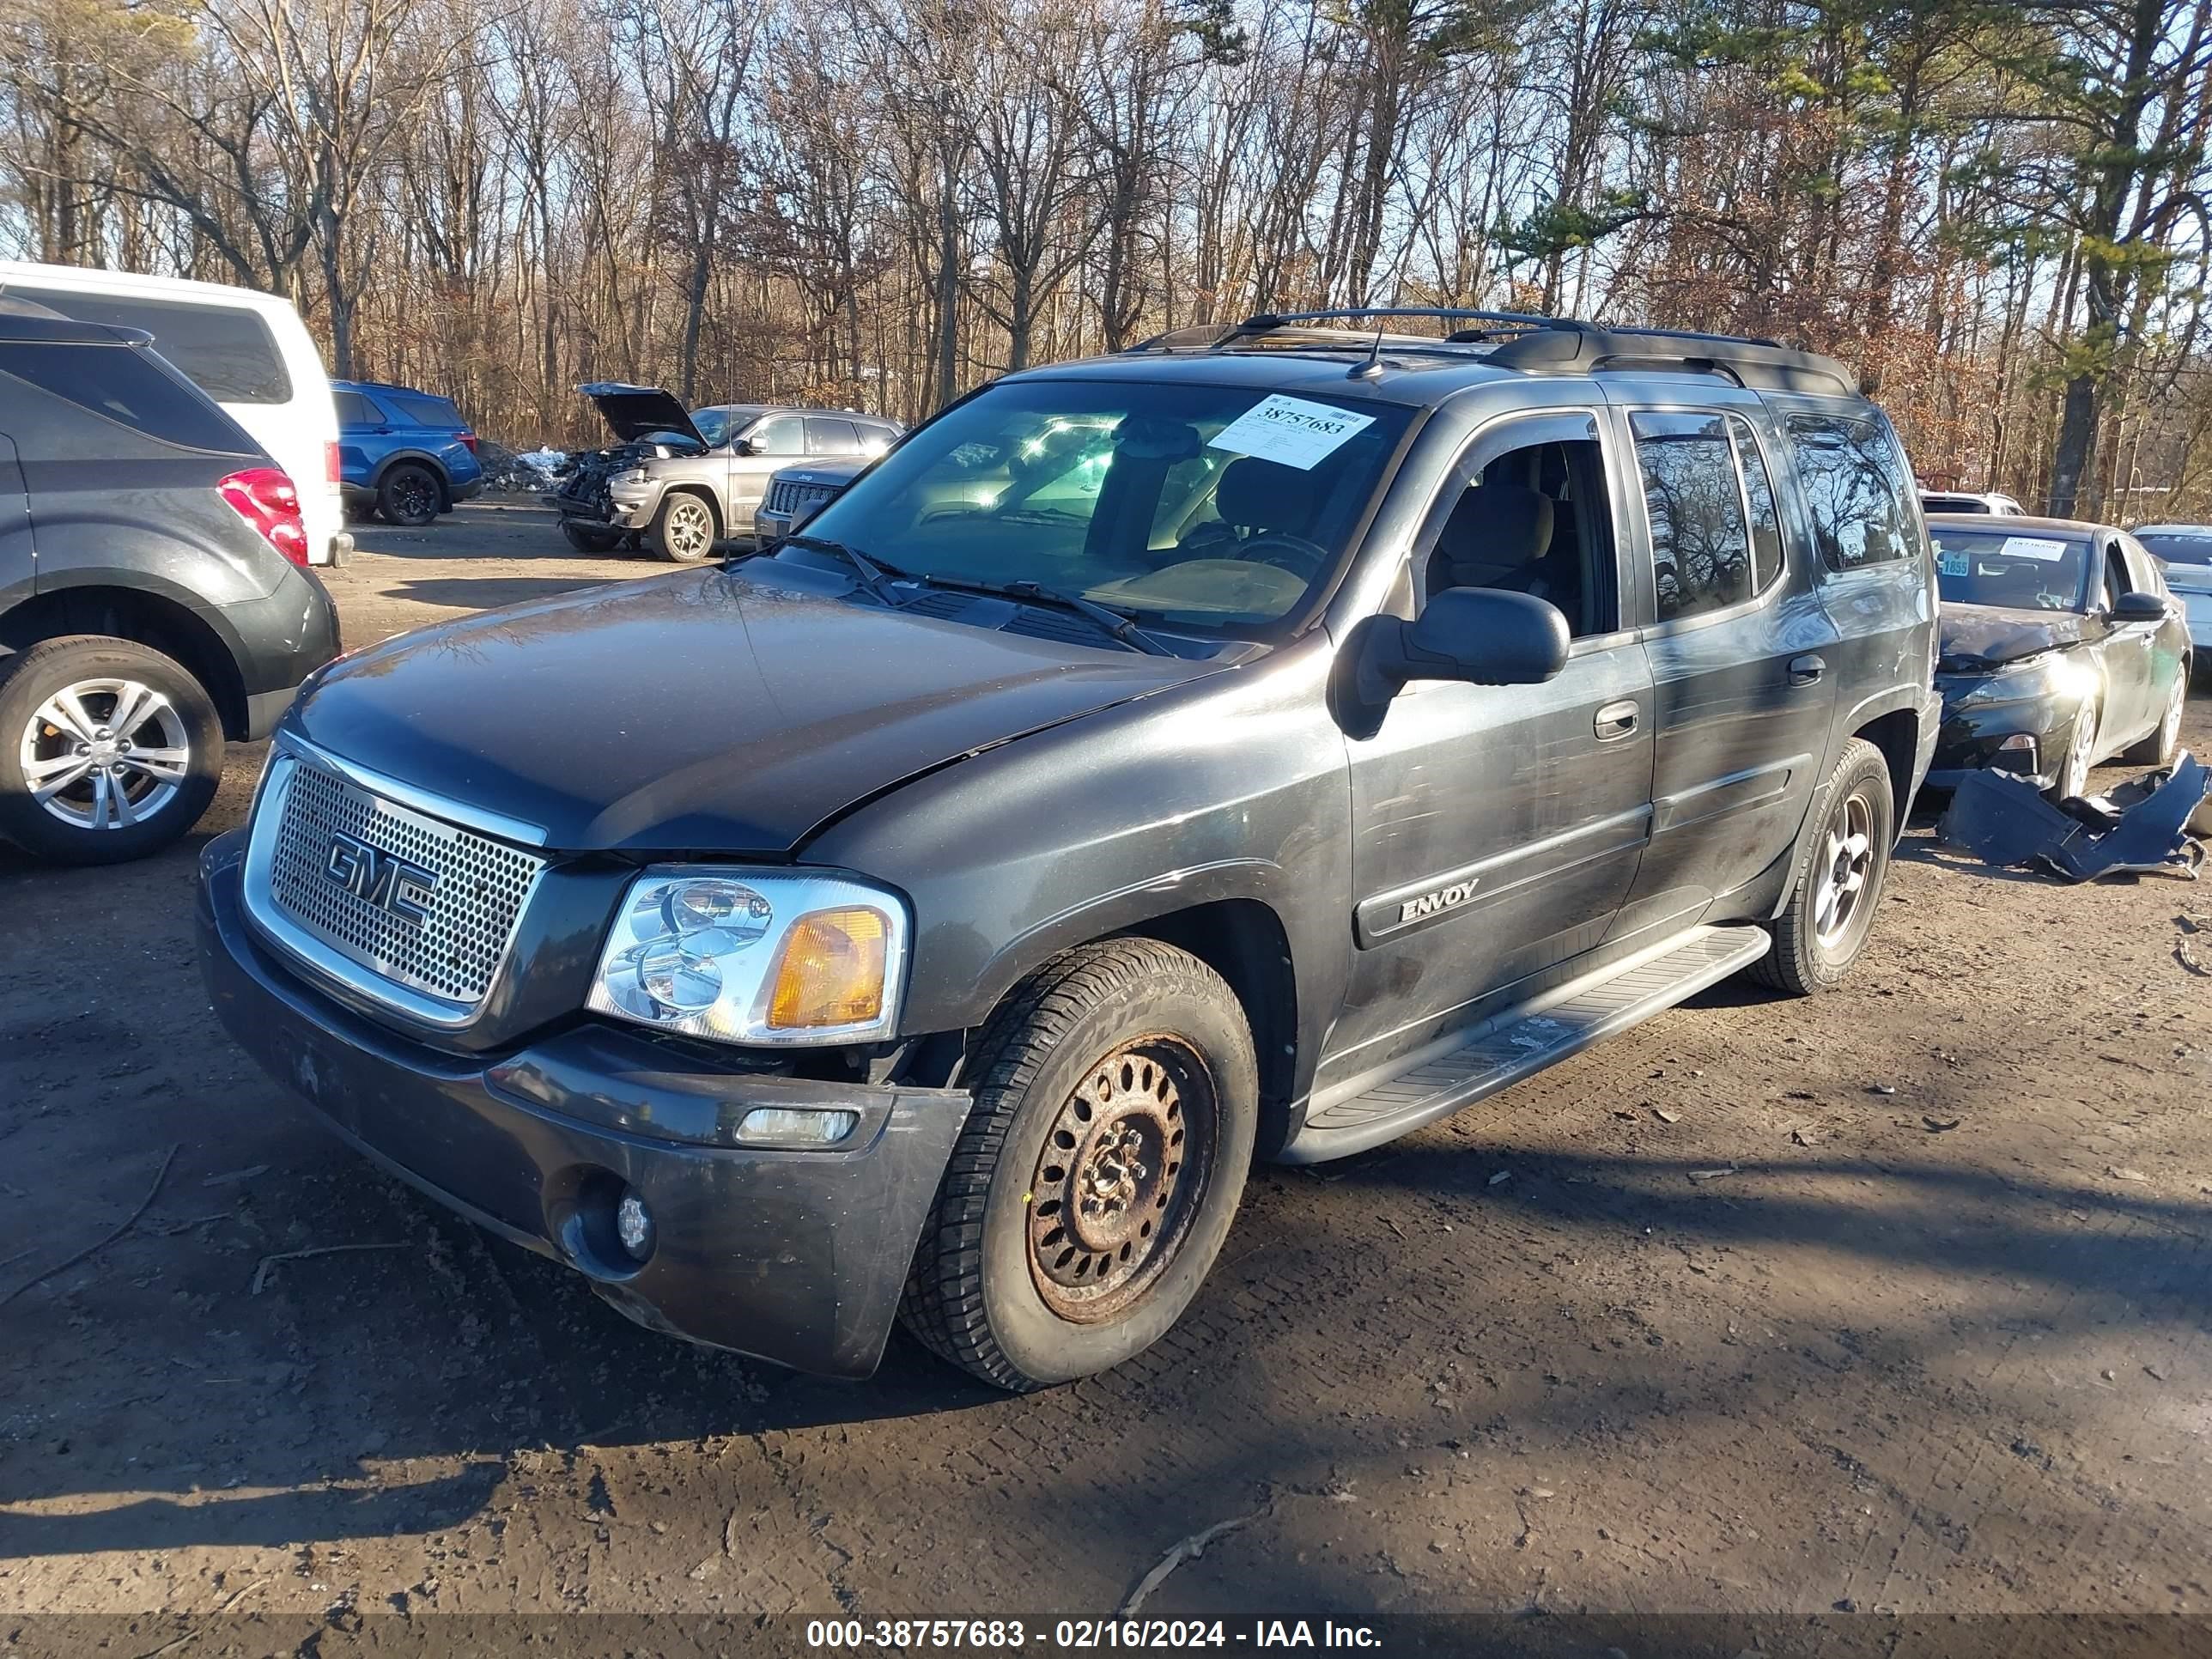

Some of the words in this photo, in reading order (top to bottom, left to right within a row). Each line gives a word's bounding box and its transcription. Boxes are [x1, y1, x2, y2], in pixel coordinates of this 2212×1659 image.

[1256, 407, 1346, 435] 38757683
[1944, 560, 1967, 574] 1855
[322, 830, 440, 928] GMC
[1400, 878, 1480, 922] ENVOY
